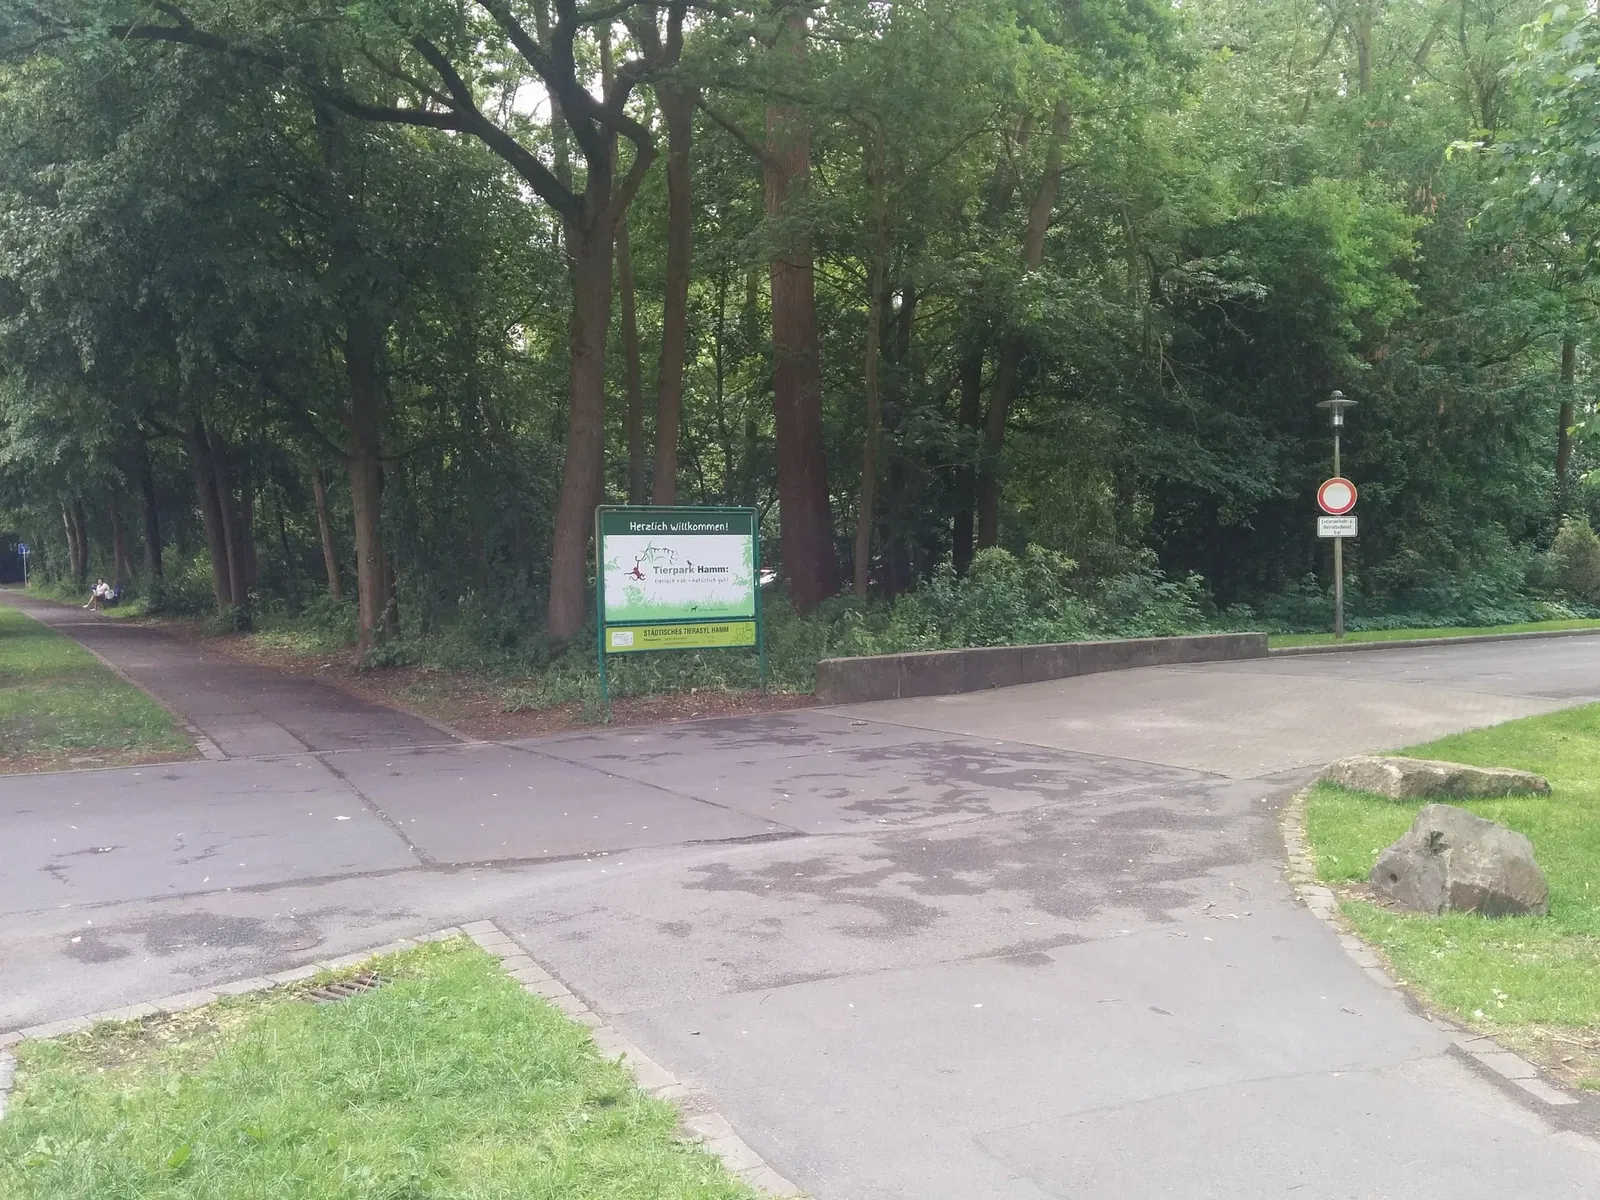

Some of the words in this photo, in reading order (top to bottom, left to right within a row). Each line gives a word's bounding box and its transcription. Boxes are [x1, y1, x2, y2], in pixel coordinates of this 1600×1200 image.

[630, 521, 668, 531] Herzlich
[652, 566, 695, 576] Tierpark
[697, 565, 729, 574] Hamm:
[643, 628, 682, 636] STÄDTISCHES
[683, 627, 710, 635] TIERASYL
